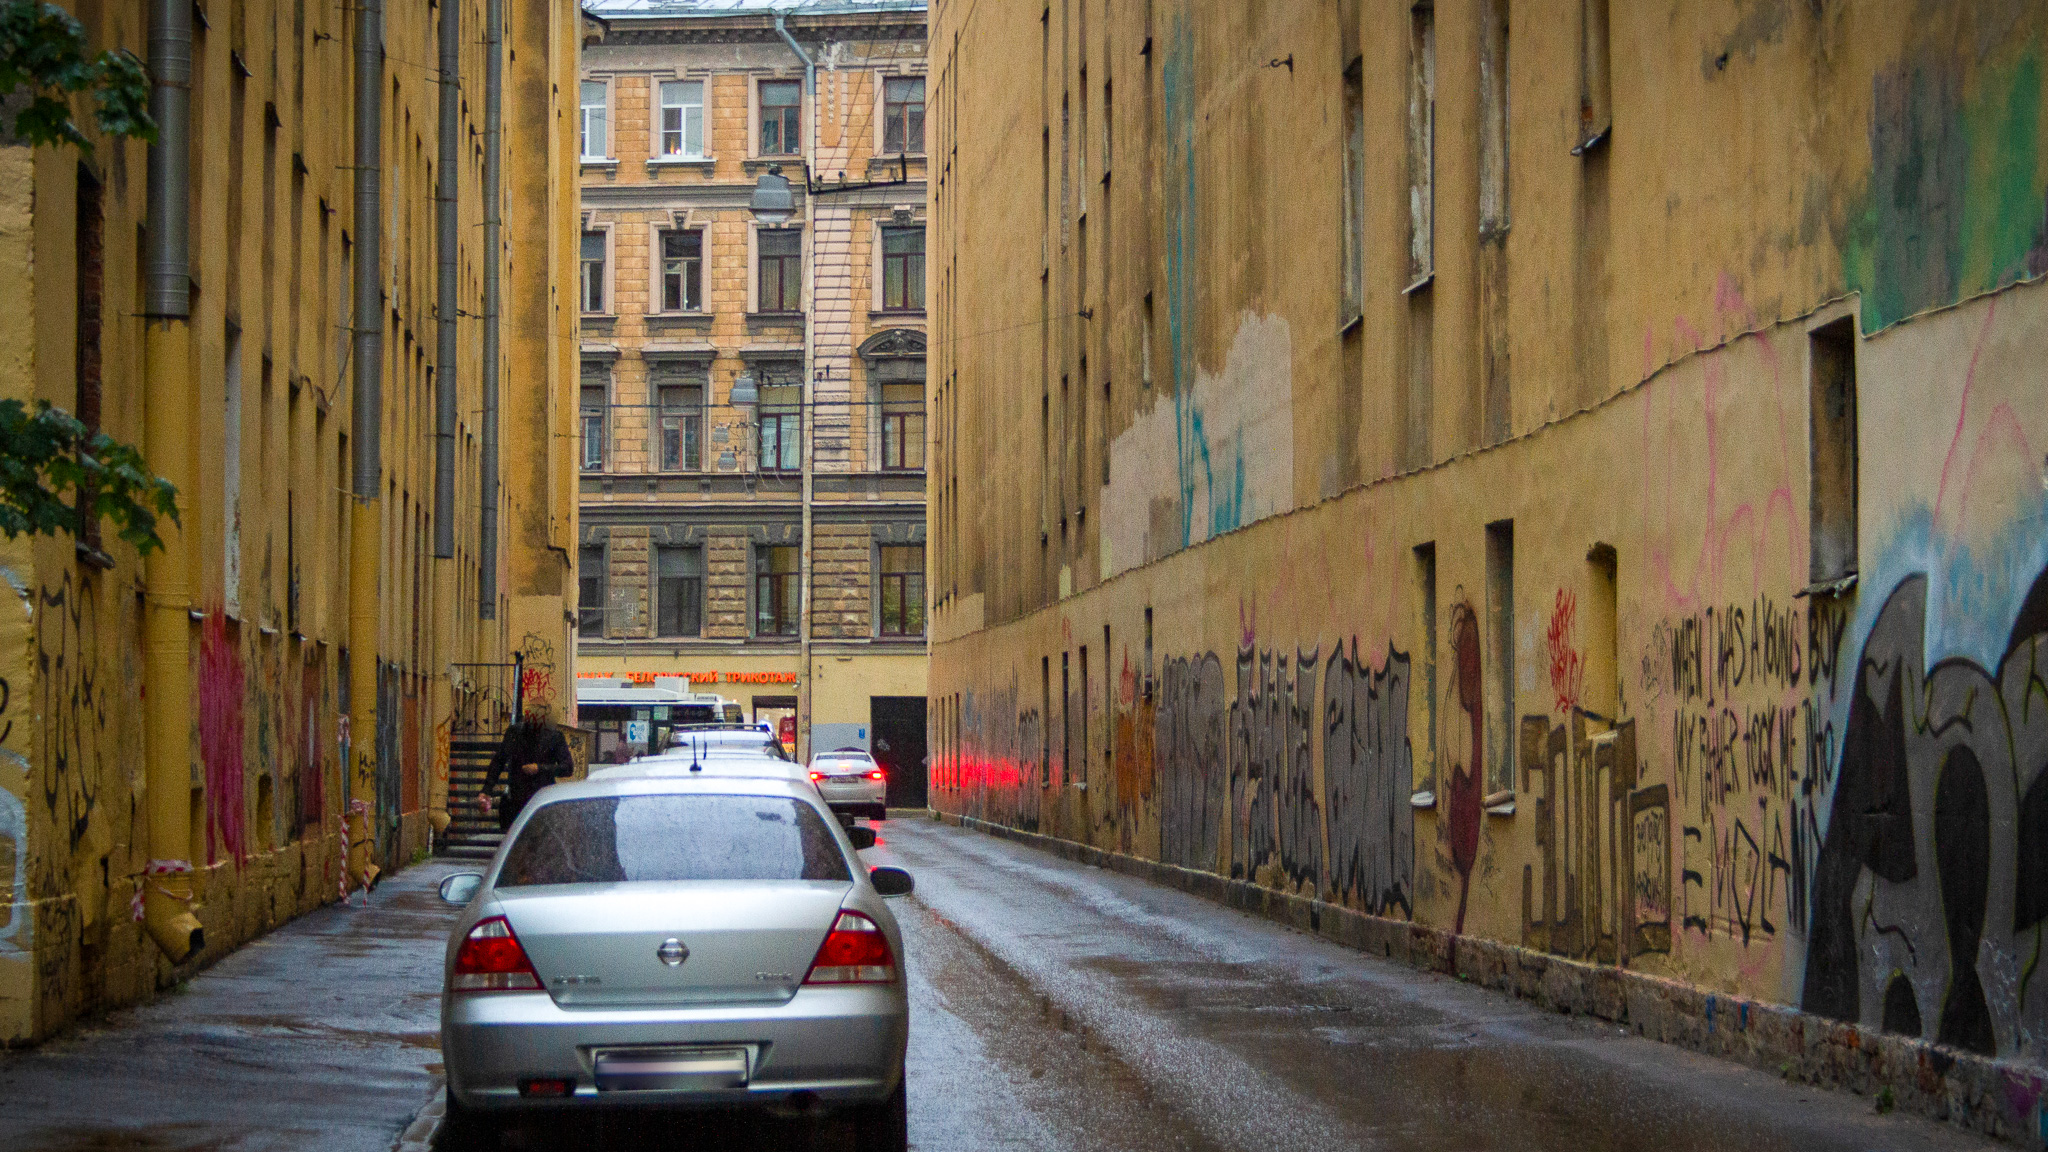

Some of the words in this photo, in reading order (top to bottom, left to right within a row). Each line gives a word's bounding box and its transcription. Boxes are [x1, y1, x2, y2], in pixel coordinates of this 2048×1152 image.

[725, 671, 796, 684] ТРИКОТАЖ
[1670, 612, 1702, 703] WHEN
[1706, 606, 1715, 708] I
[1717, 603, 1745, 700] WAS
[1750, 599, 1761, 685] A
[1761, 592, 1801, 690] YOUNG
[1808, 604, 1846, 701] BOY
[1673, 706, 1695, 807] MY
[1779, 705, 1798, 803] ME
